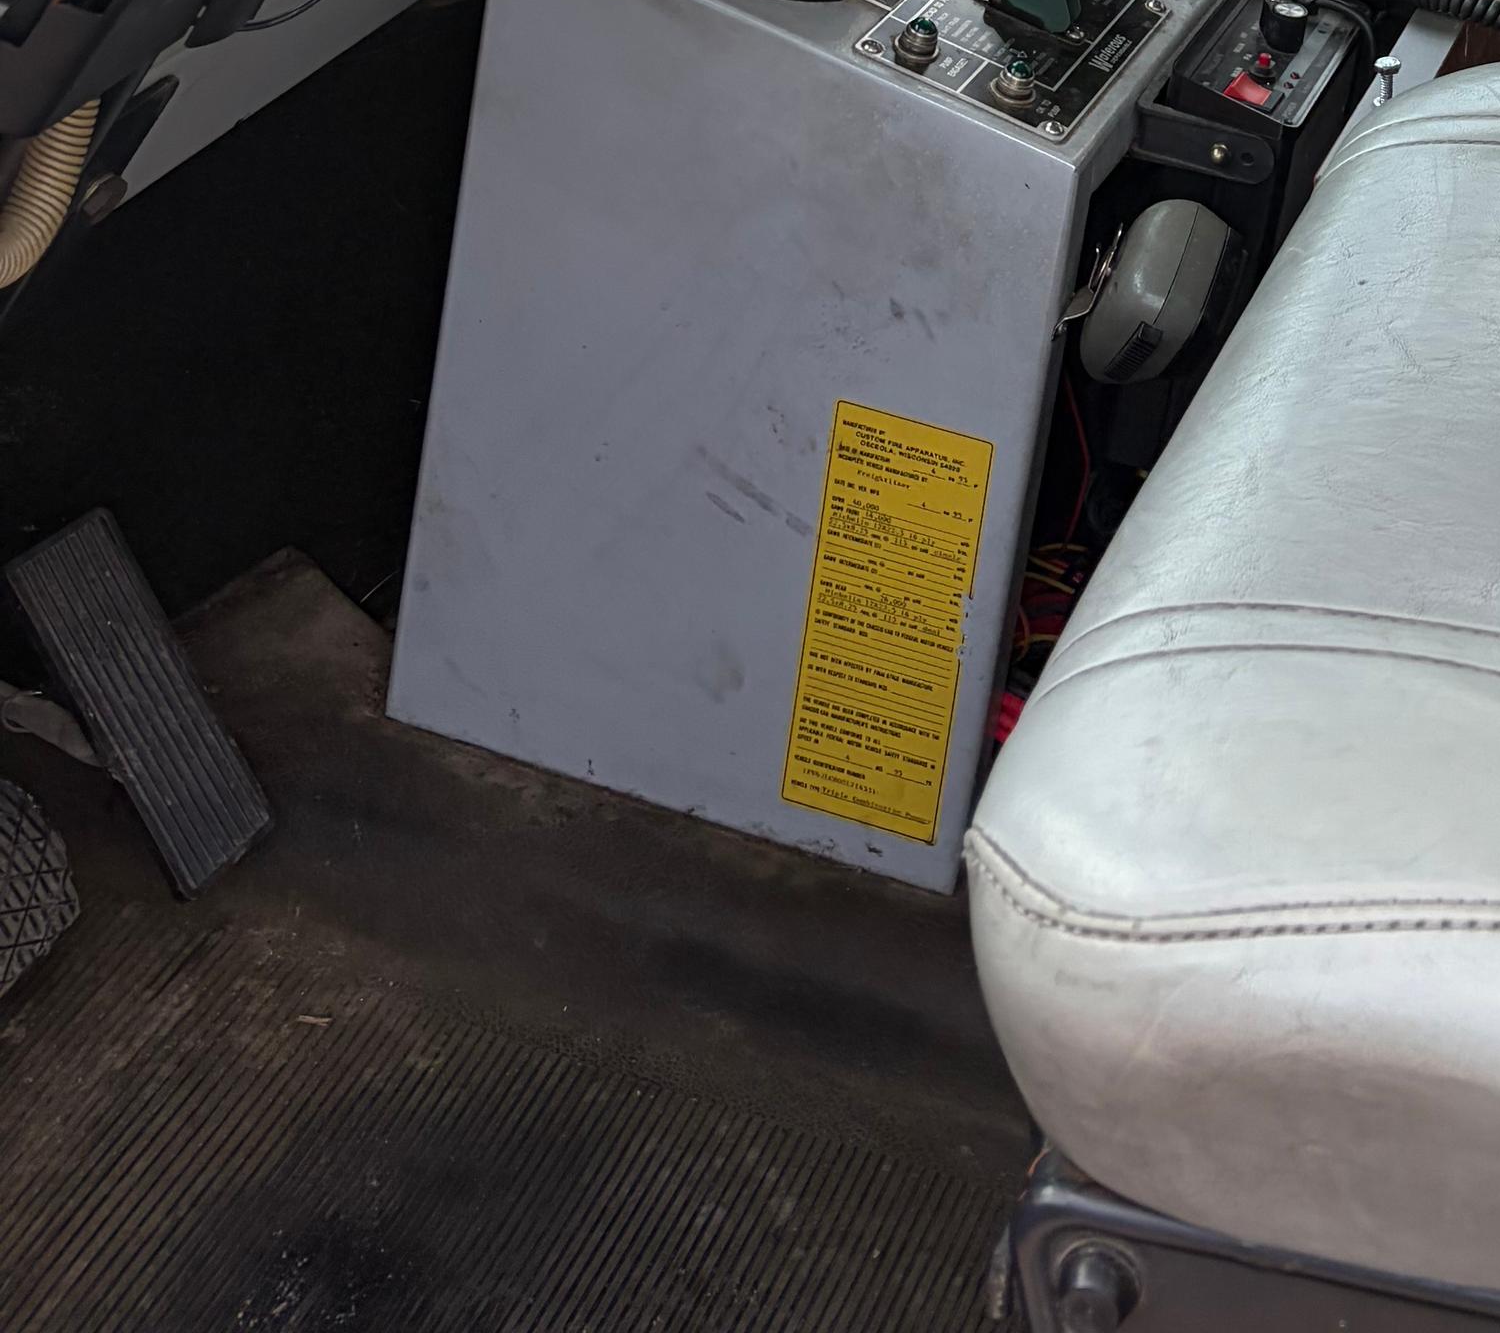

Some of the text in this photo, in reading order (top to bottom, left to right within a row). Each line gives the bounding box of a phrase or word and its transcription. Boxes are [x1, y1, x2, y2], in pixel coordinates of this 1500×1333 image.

[1088, 33, 1136, 73] Waterous
[855, 431, 886, 445] CUSTOM
[887, 440, 902, 450] FIRE
[899, 451, 938, 467] WISCONSIN
